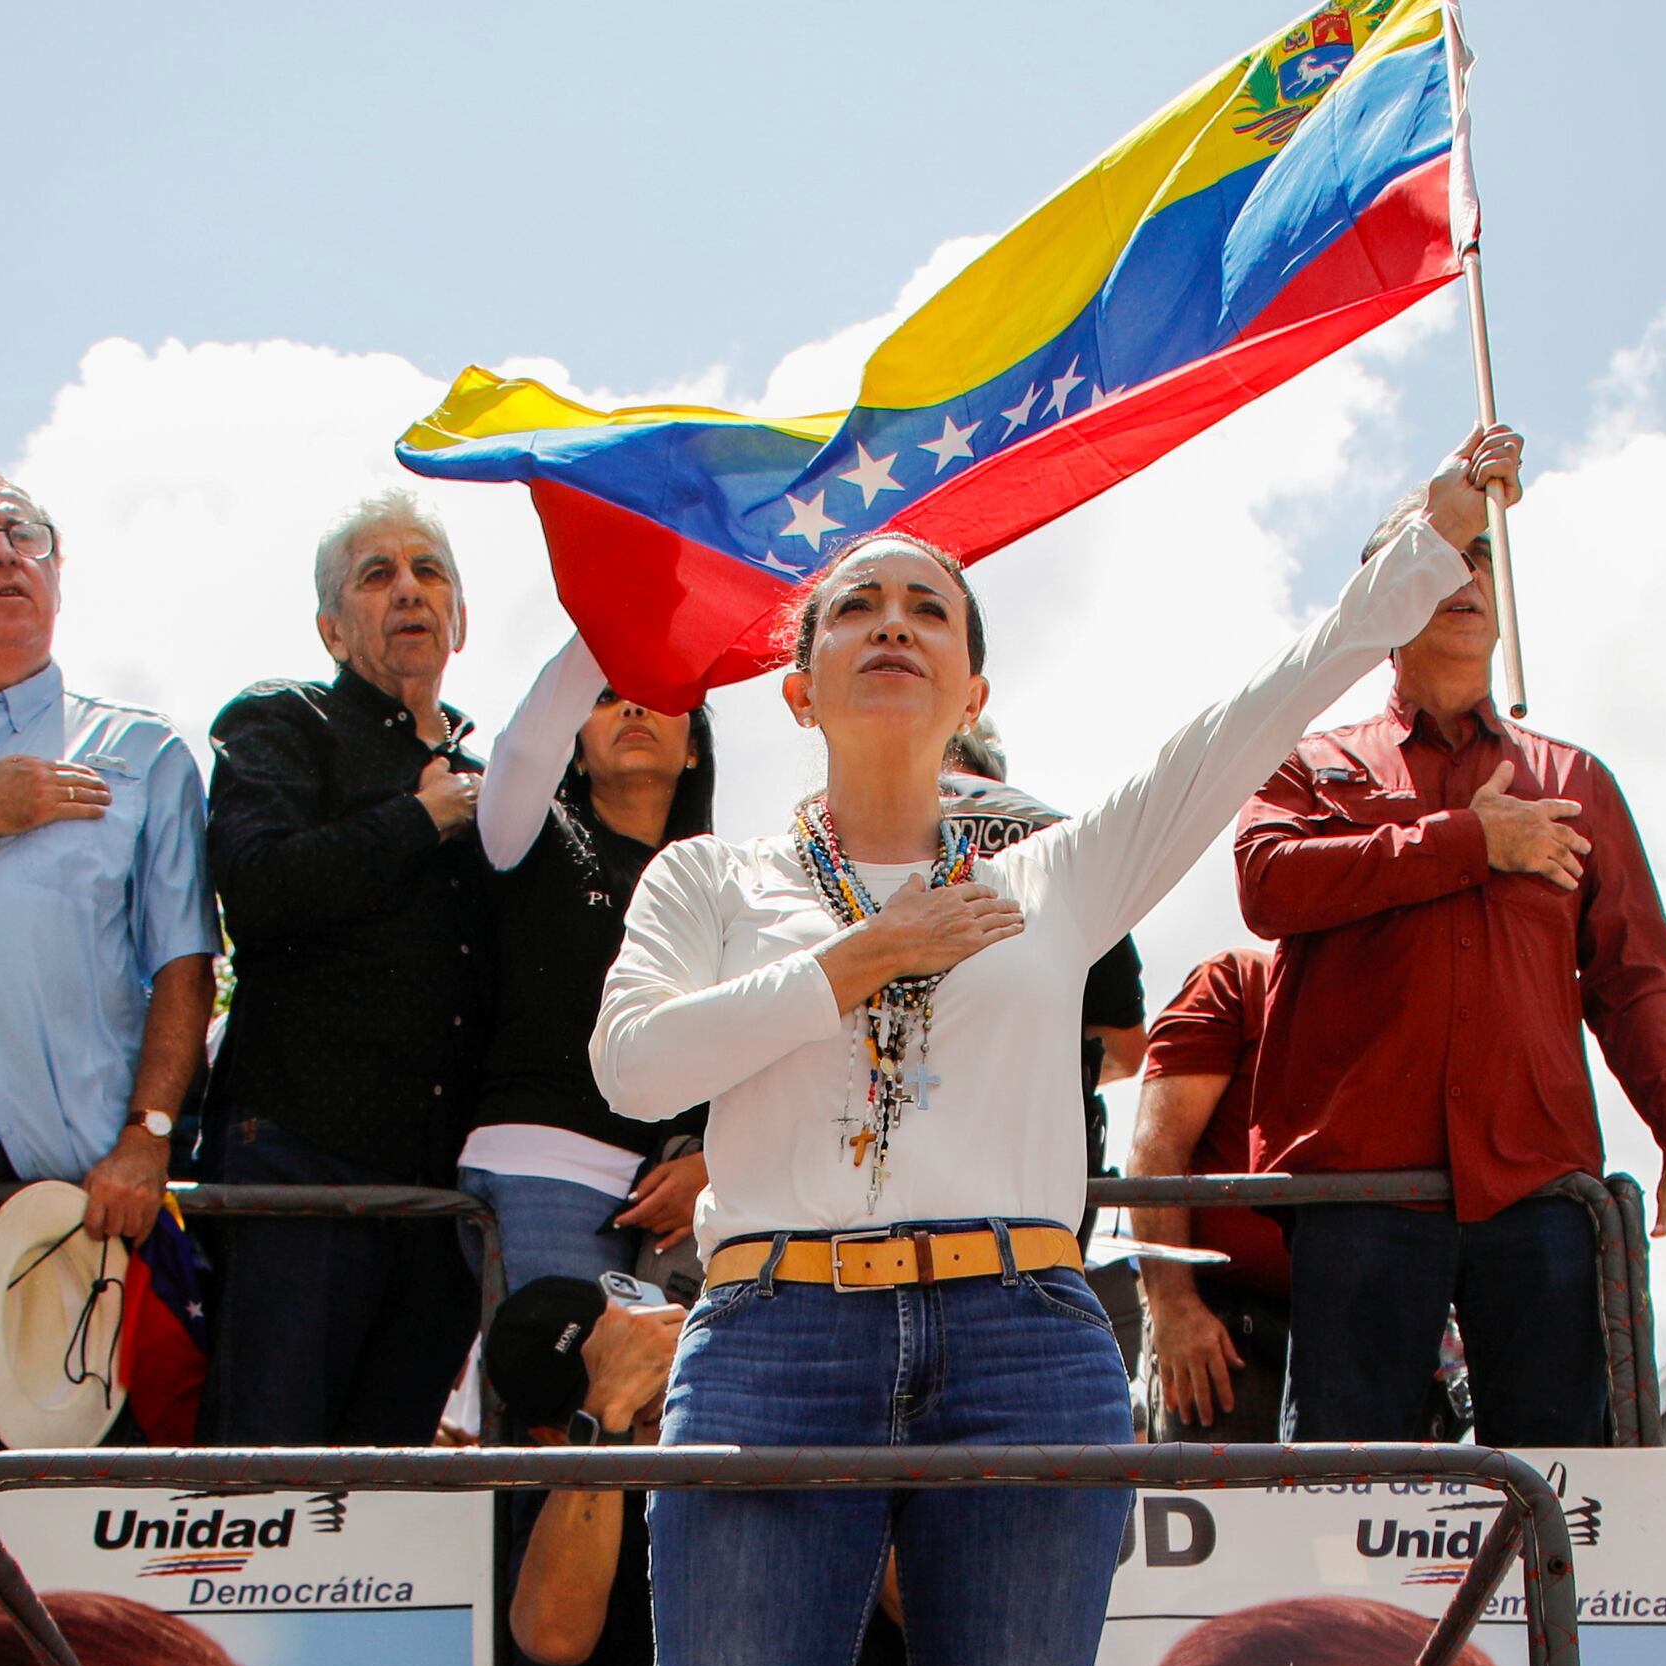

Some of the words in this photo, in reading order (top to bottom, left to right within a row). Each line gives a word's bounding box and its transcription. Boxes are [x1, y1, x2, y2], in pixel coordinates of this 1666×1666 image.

[959, 818, 1024, 850] DICO
[555, 1322, 578, 1353] BOSS
[93, 1508, 295, 1550] Unidad
[1356, 1519, 1482, 1560] Unid
[189, 1576, 413, 1605] Democrática
